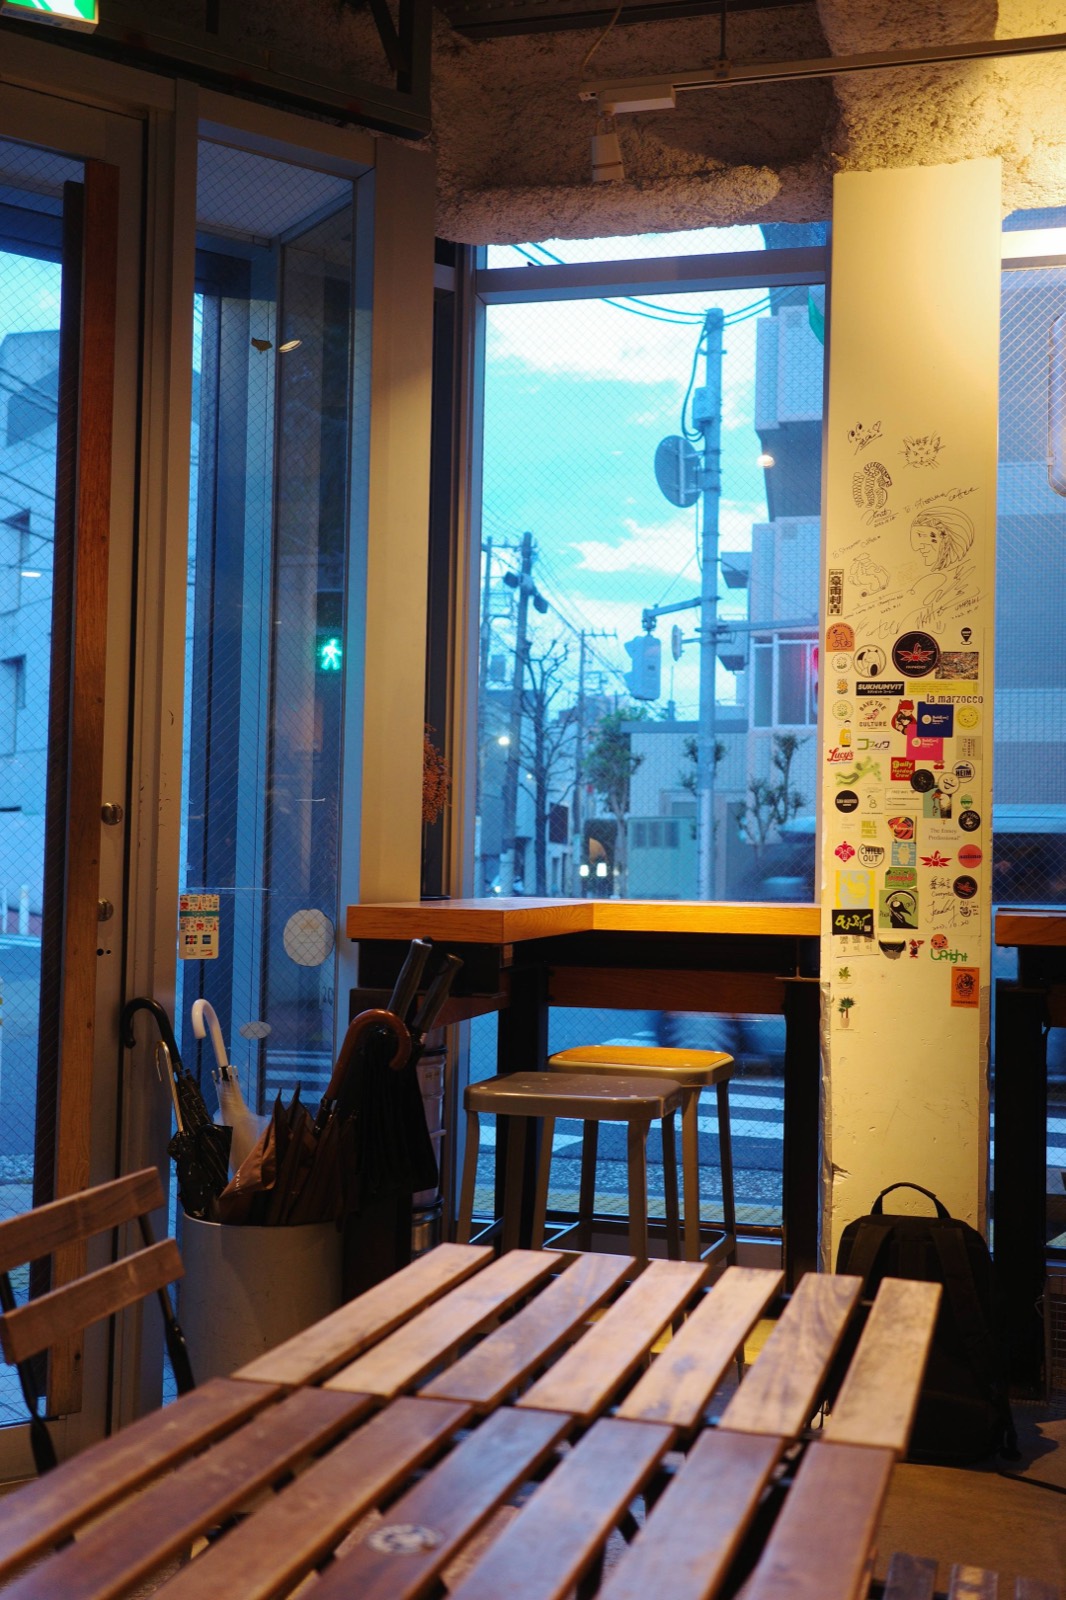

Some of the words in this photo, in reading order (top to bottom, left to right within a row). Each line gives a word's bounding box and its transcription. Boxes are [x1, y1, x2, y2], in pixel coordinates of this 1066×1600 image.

[926, 693, 935, 703] la
[937, 695, 984, 704] marzocco
[859, 700, 874, 711] SAVE
[875, 701, 887, 711] THE
[827, 747, 854, 762] Lucy's
[892, 760, 913, 769] Daily
[862, 854, 879, 862] OUT
